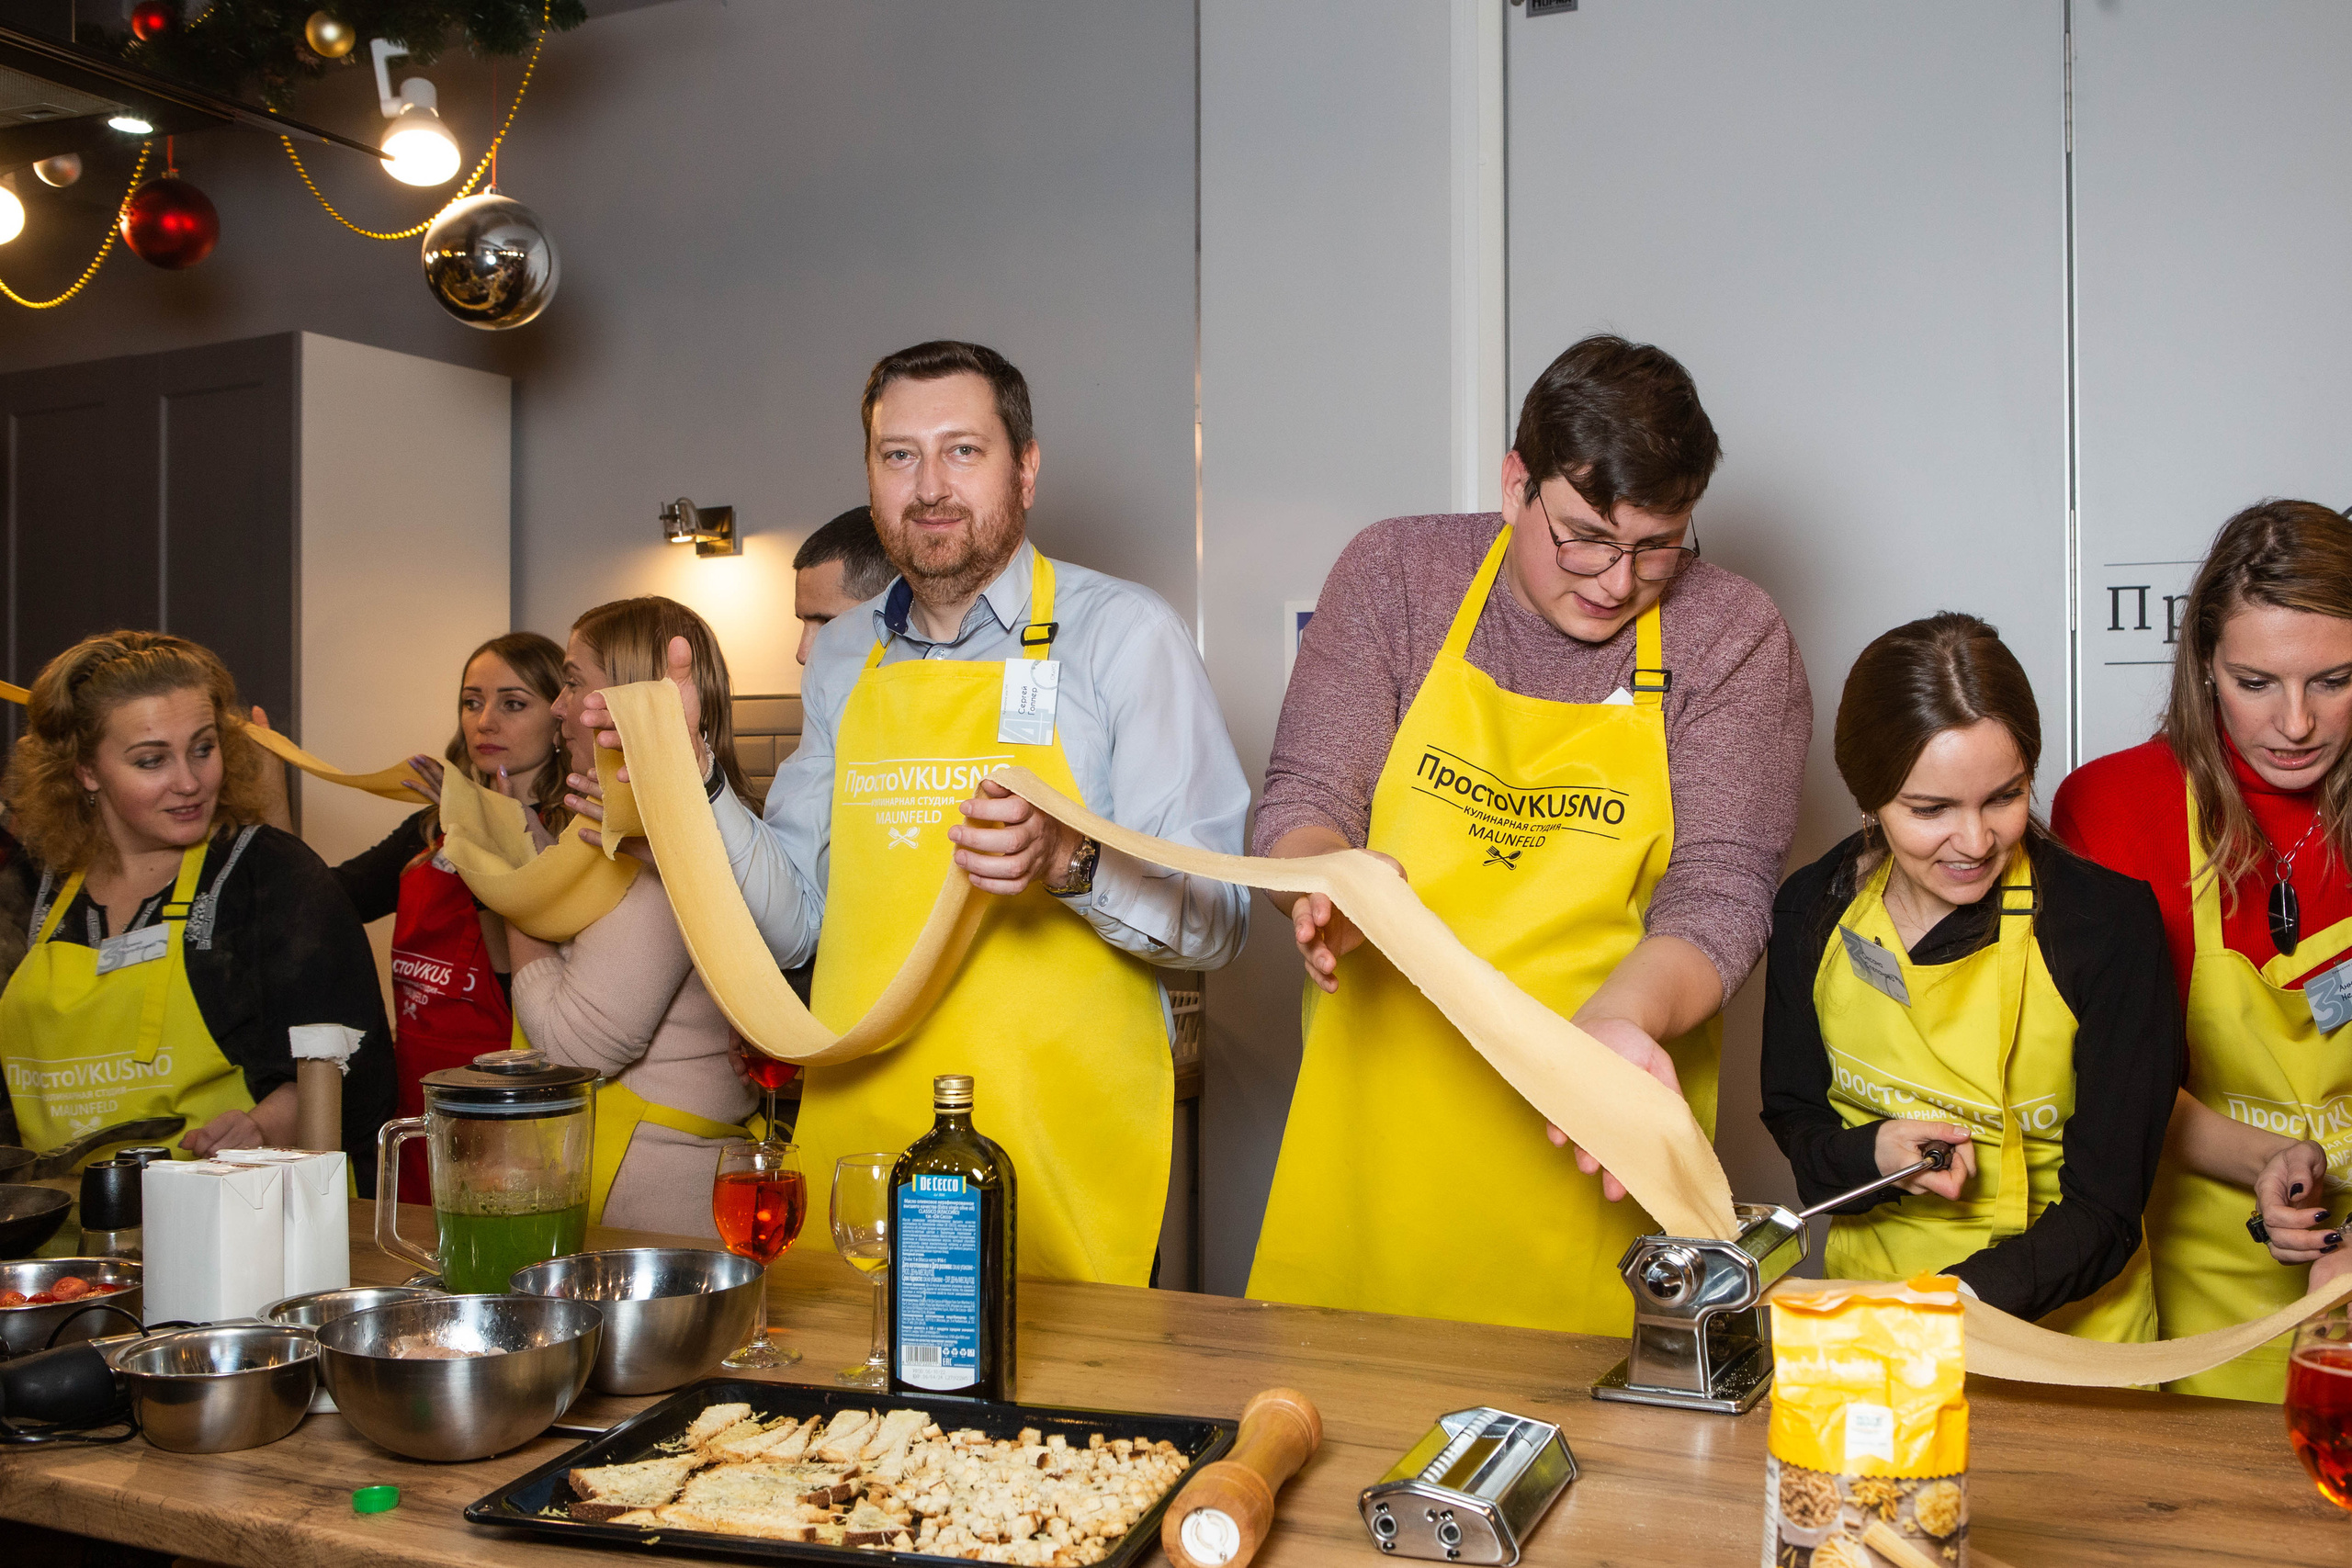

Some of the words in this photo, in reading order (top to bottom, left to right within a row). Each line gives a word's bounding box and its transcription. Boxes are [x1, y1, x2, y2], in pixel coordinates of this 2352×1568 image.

[1417, 753, 1625, 825] ПростоVKUSNO
[917, 796, 955, 807] СТУДИЯ
[876, 810, 943, 825] MAUNFELD
[1464, 806, 1529, 831] КУЛИНАРНАЯ
[1530, 823, 1562, 832] СТУДИЯ
[1468, 823, 1546, 848] MAUNFELD
[51, 1100, 118, 1117] MAUNFELD
